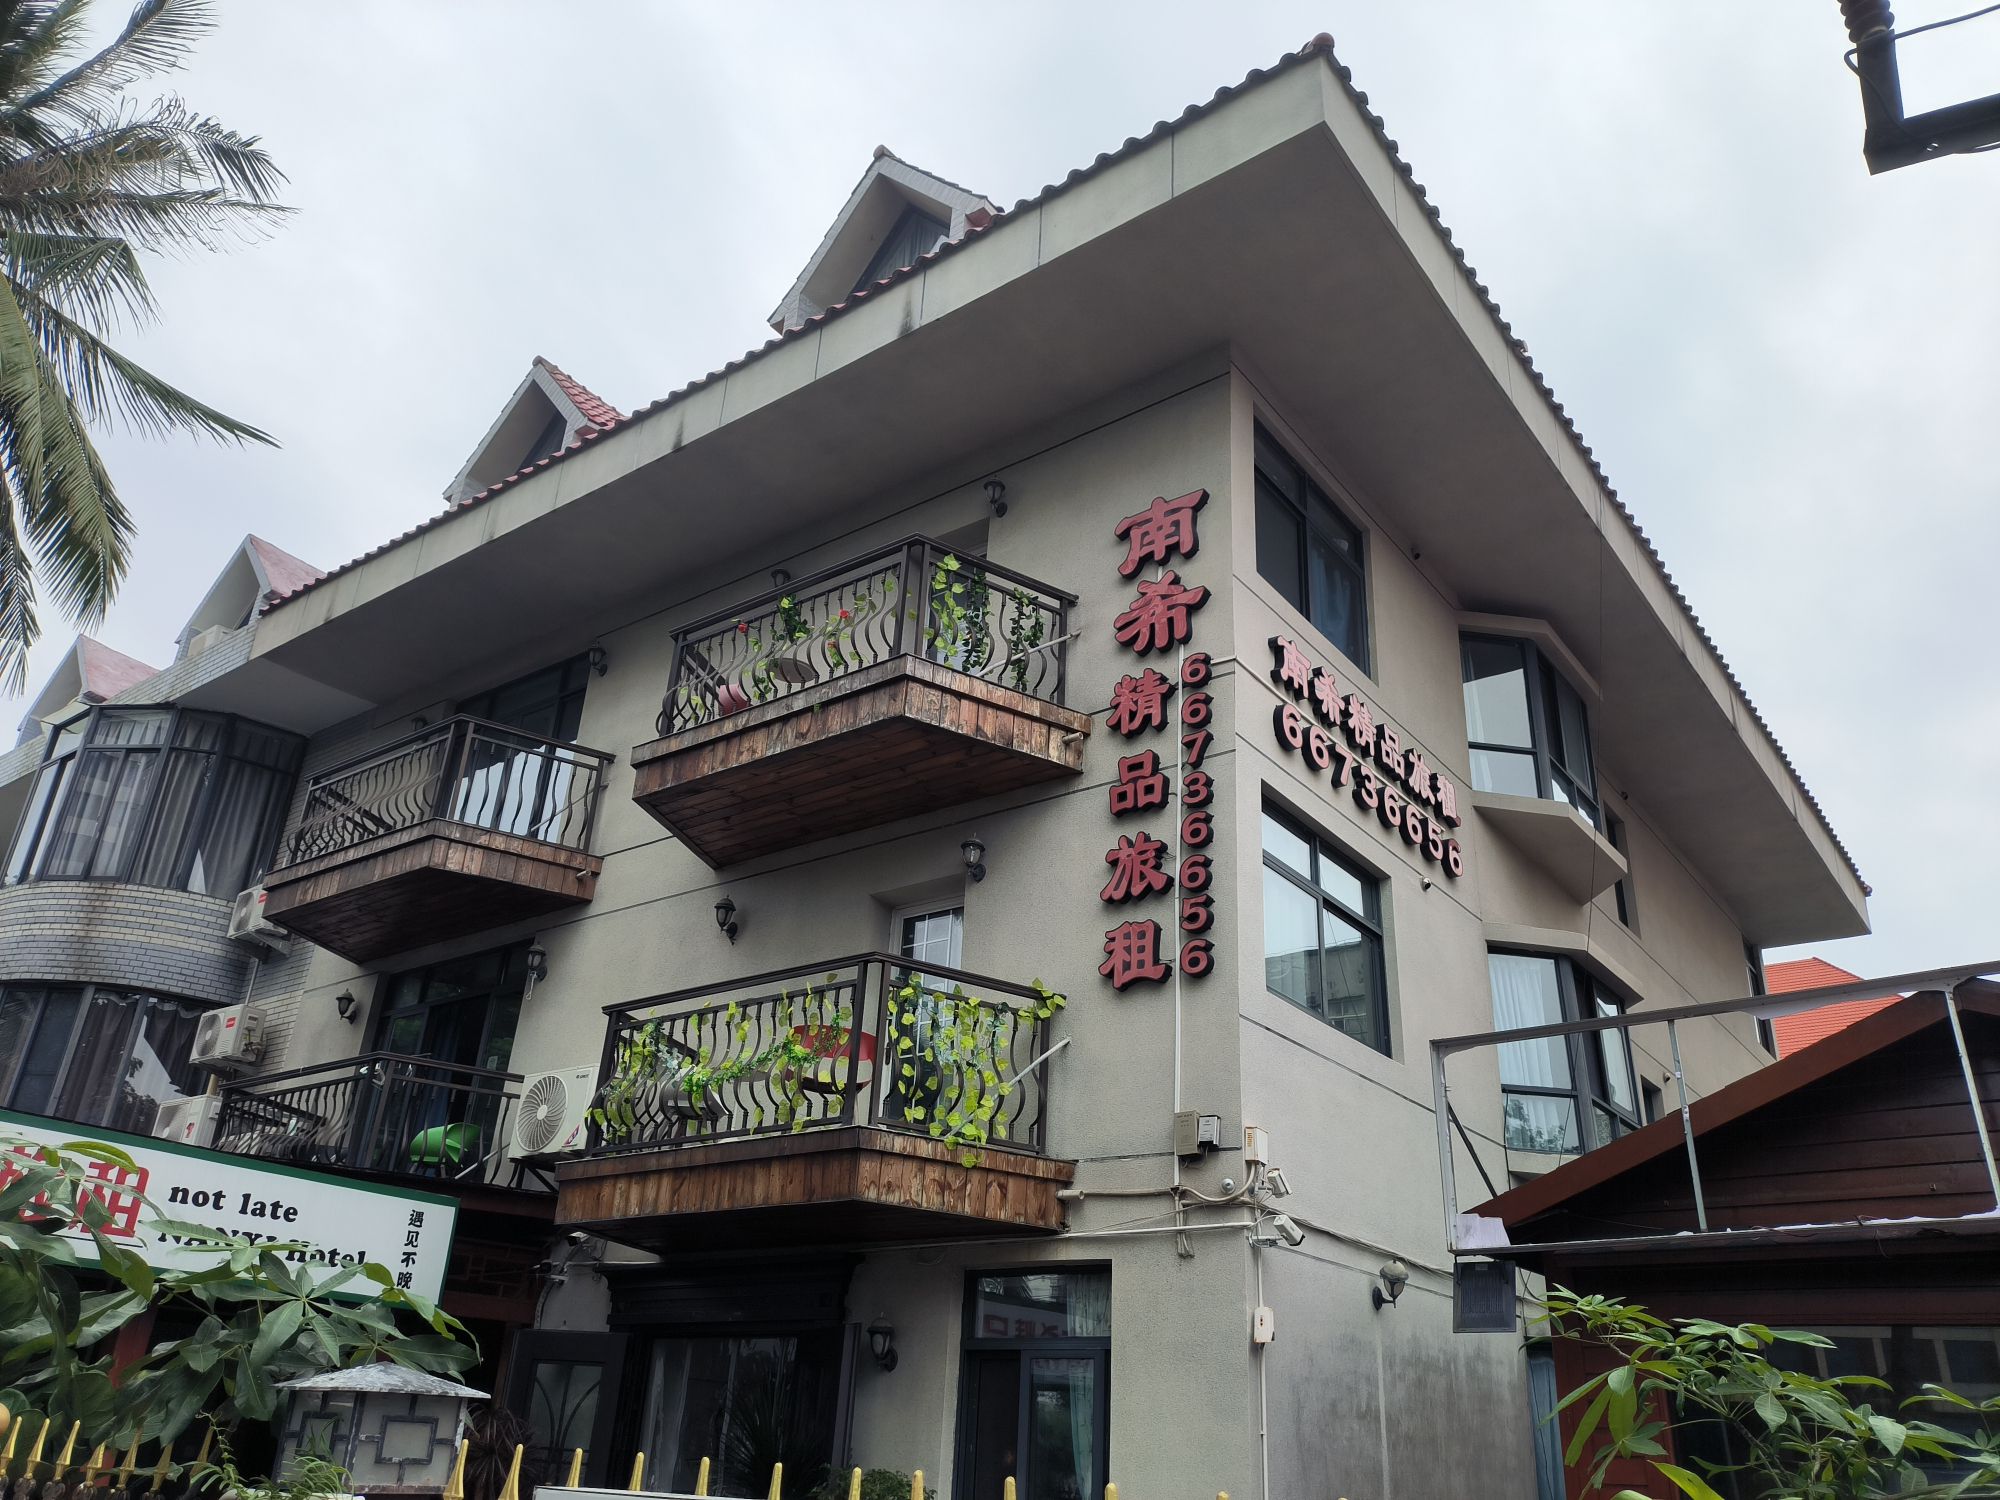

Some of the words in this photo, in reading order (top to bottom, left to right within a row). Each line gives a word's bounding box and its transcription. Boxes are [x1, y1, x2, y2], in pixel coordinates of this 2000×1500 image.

[1098, 488, 1211, 992] 南希精品旅租
[1180, 652, 1214, 978] 66736656
[1269, 635, 1461, 828] 南希精品旅租
[1273, 703, 1464, 878] 66736656
[168, 1186, 226, 1211] not
[238, 1193, 299, 1223] late
[396, 1209, 424, 1290] 遇见不晚
